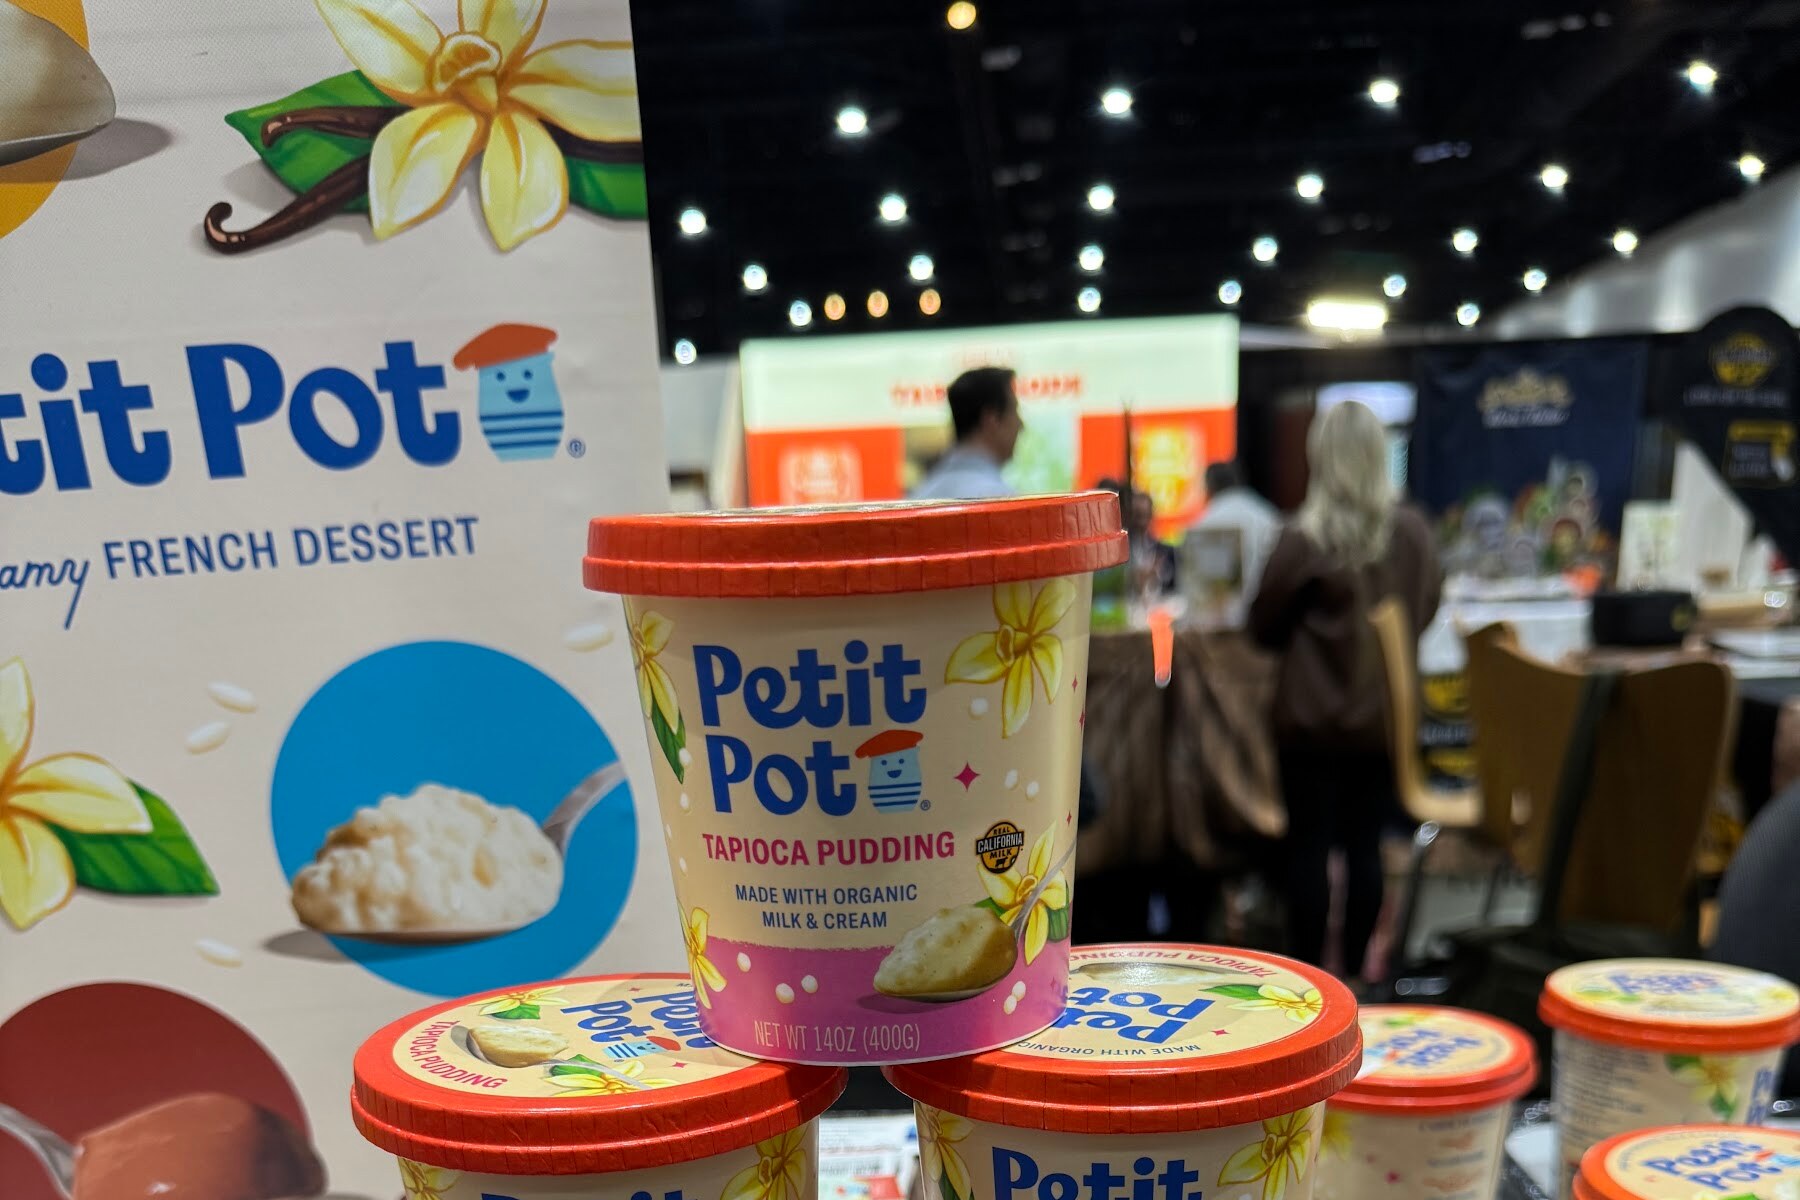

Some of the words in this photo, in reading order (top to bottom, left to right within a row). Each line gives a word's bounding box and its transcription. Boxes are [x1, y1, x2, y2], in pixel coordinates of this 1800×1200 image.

[185, 341, 462, 480] Pot
[103, 530, 278, 580] FRENCH
[293, 515, 481, 566] DESSERT
[692, 640, 928, 729] Petit
[705, 734, 857, 817] Pot
[702, 833, 810, 866] TAPIOCA
[817, 831, 955, 865] PUDDING
[977, 832, 1023, 854] CALIFORNIA
[735, 884, 779, 903] MADE
[782, 886, 827, 905] WITH
[833, 884, 918, 904] ORGANIC
[762, 911, 801, 929] MILK
[806, 912, 819, 929] &
[824, 911, 888, 929] CREAM
[1068, 987, 1216, 1020] Pot
[560, 1000, 655, 1044] Pot
[754, 1020, 781, 1048] NET
[785, 1024, 807, 1050] WT
[814, 1025, 856, 1053] 14OZ
[863, 1023, 921, 1053] (400G)
[409, 1020, 461, 1060] TAPIOCA
[1101, 1044, 1147, 1056] WITH
[1152, 1043, 1202, 1055] MADE
[420, 1055, 509, 1090] PUDDING
